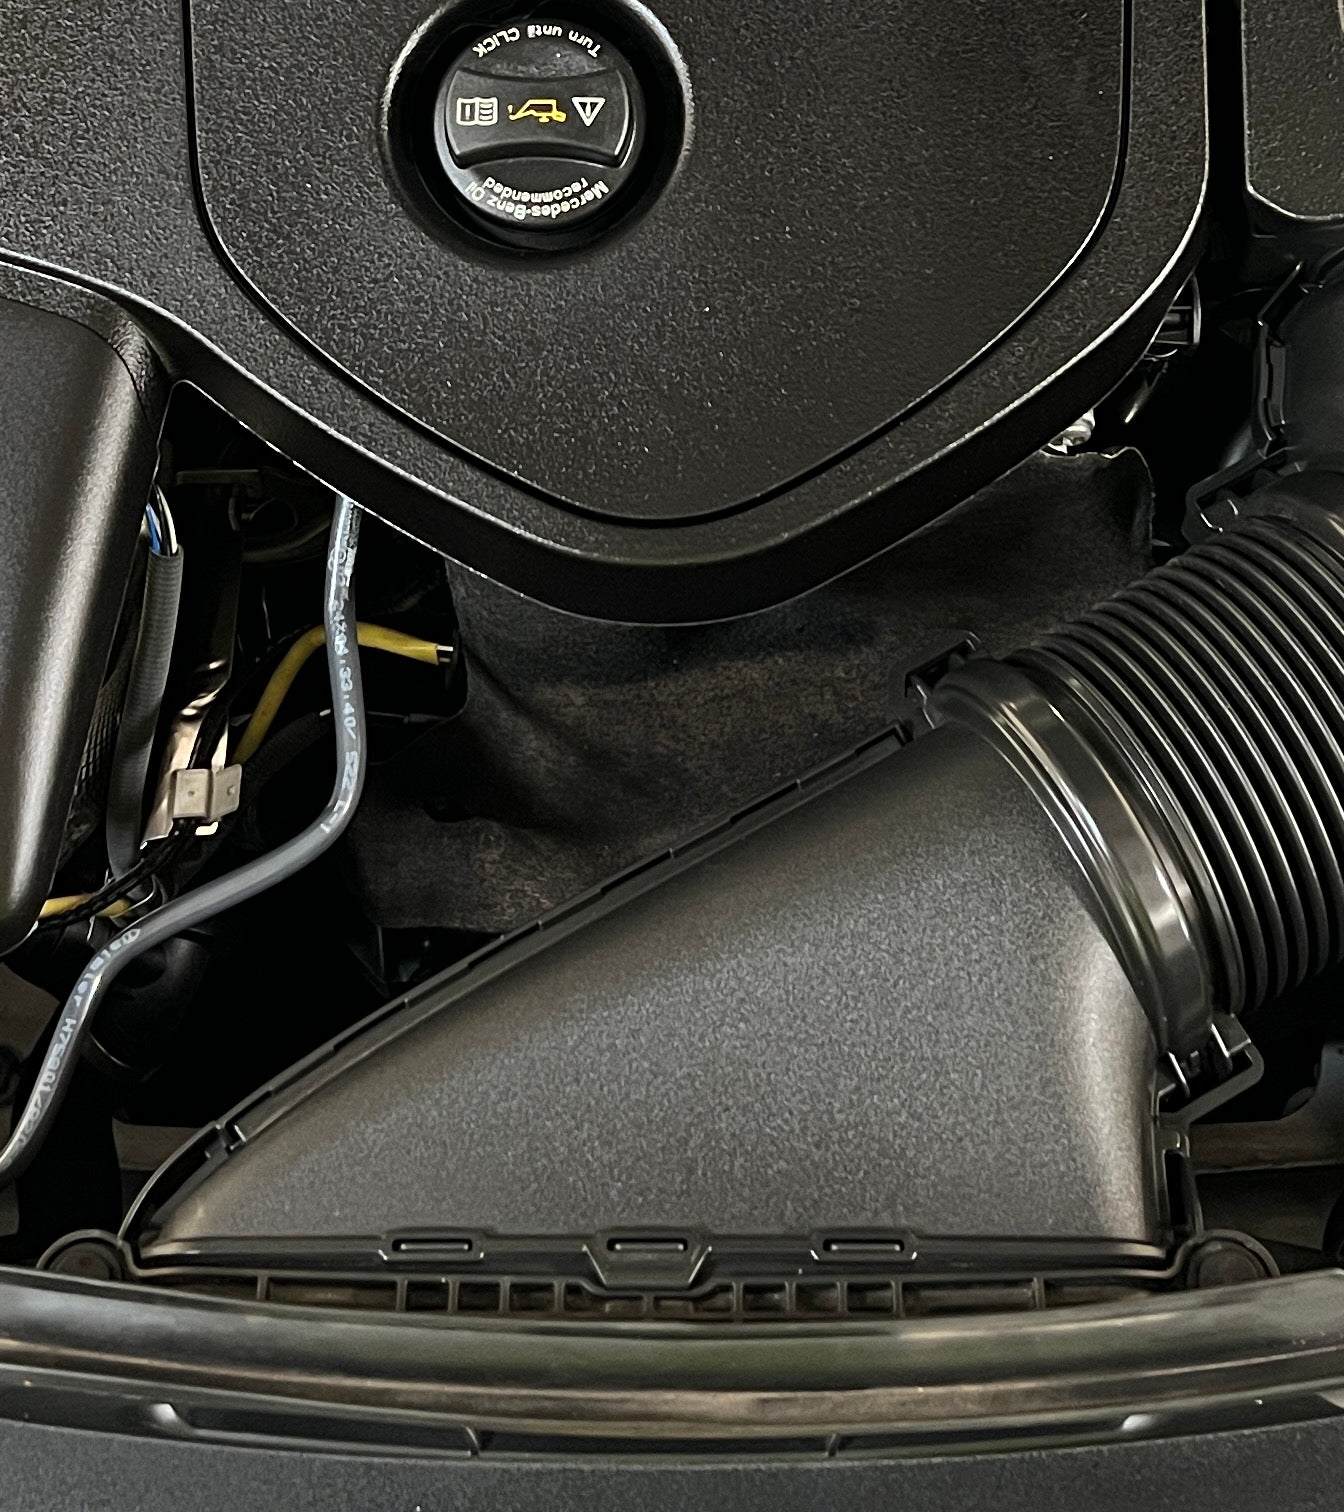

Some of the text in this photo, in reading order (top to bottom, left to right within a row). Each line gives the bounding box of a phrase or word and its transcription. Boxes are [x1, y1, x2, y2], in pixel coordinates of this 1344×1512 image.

[471, 24, 602, 59] Turn until CLICK
[464, 178, 610, 221] Mercedes-Benz Oil
[482, 175, 589, 204] recommended
